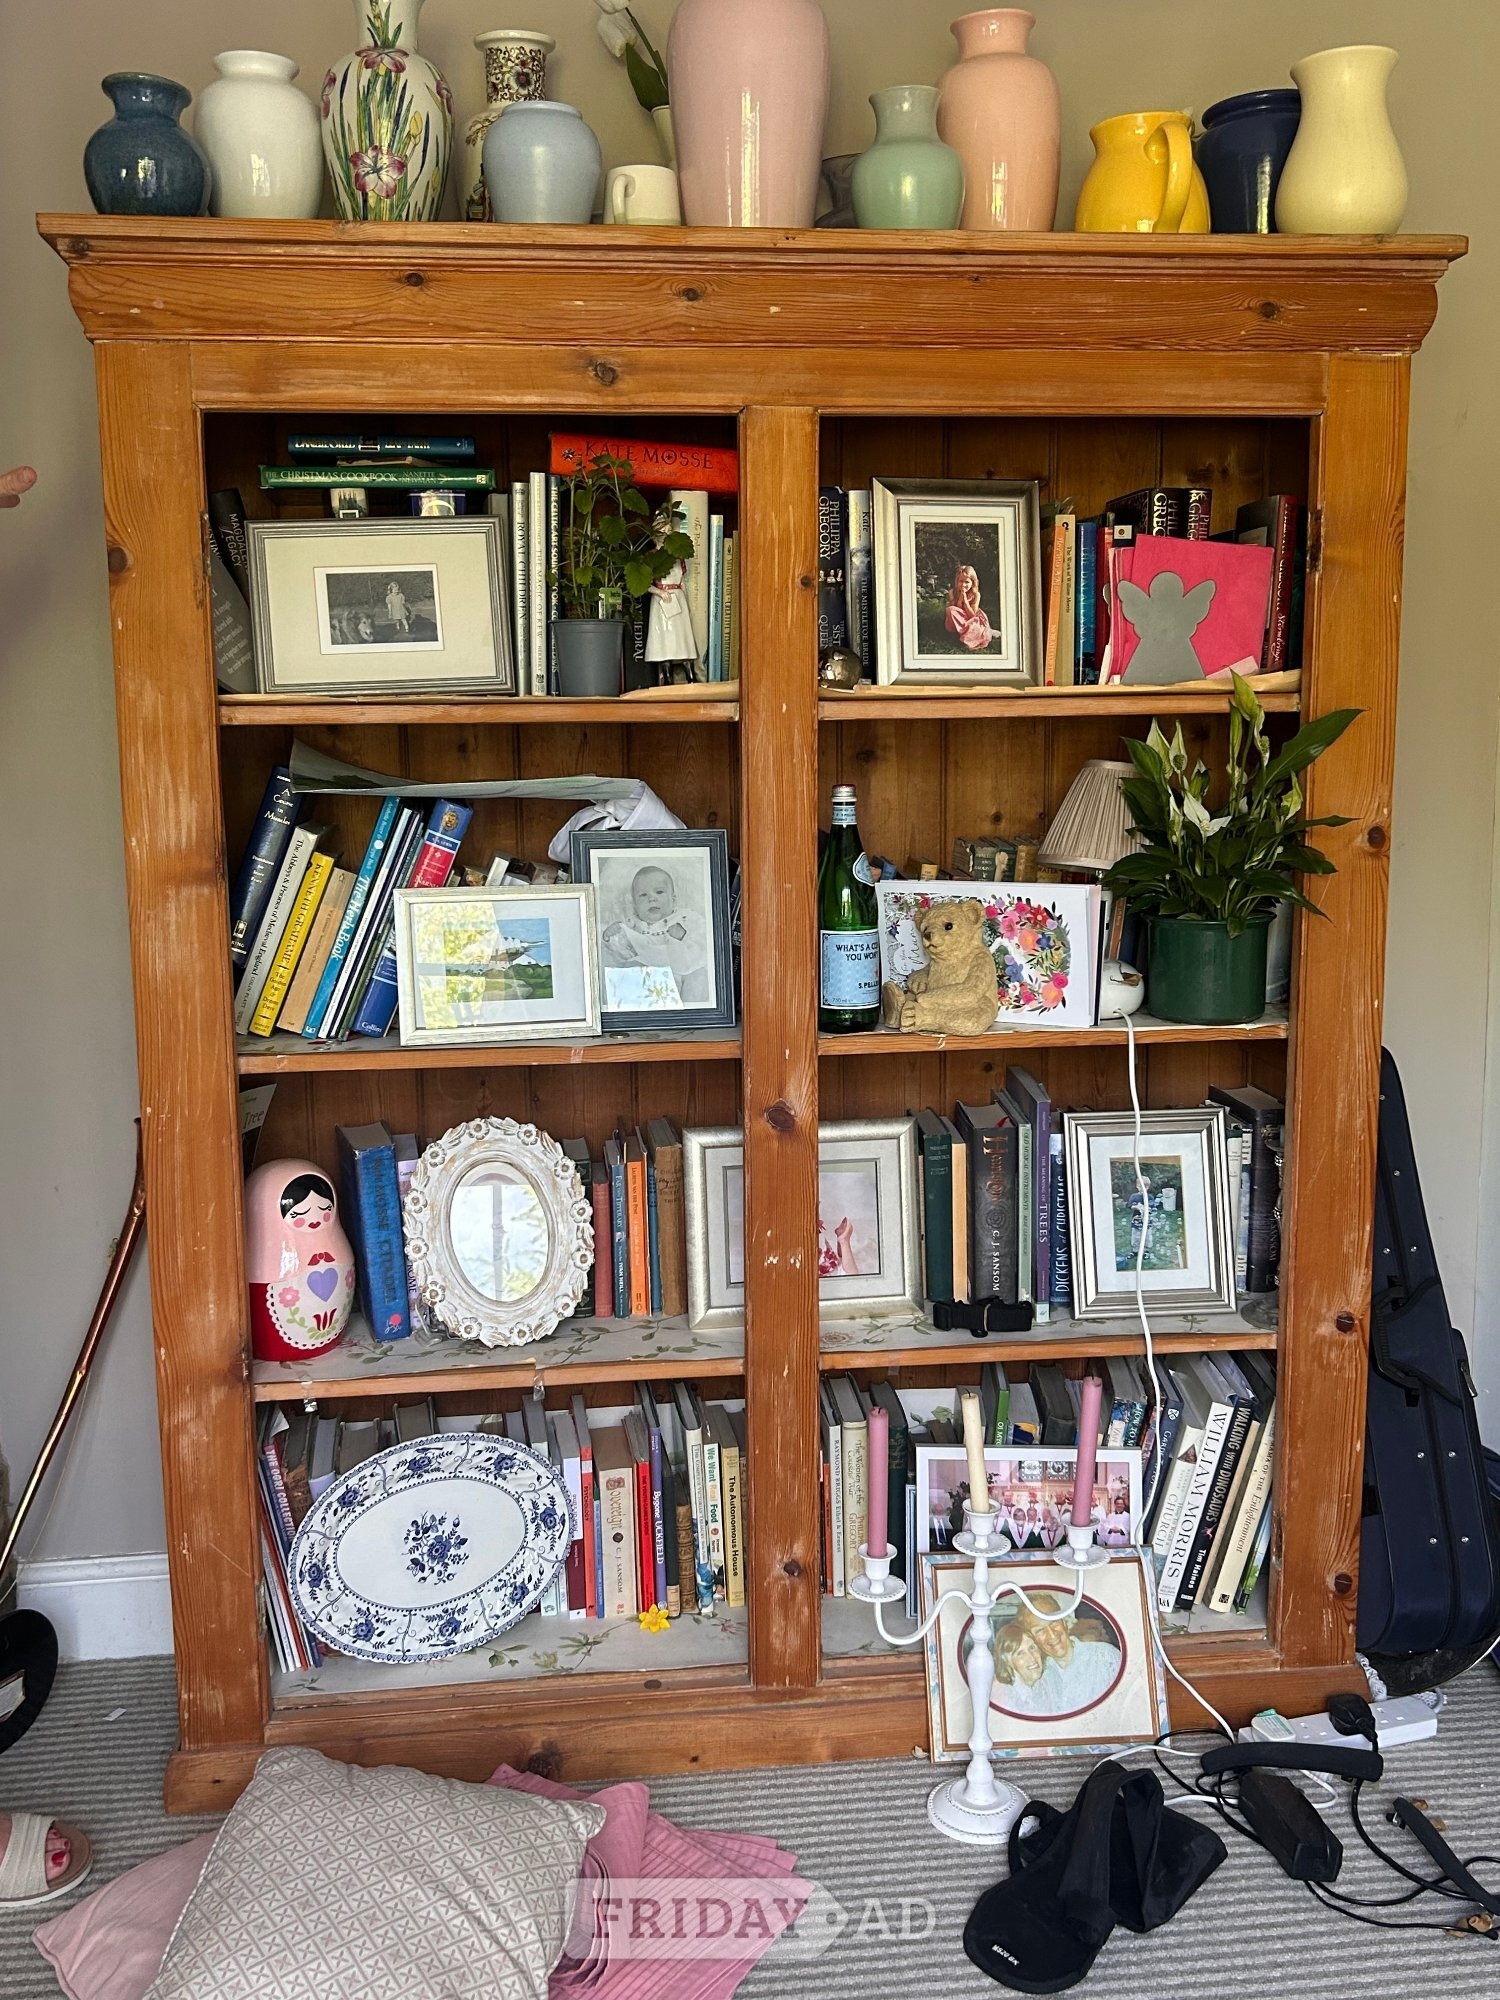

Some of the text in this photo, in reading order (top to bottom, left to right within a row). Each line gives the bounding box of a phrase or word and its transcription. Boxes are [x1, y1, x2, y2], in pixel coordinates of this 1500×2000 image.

[585, 440, 714, 469] KATE MOSSE
[281, 470, 337, 480] CHRISTMAS
[340, 471, 397, 482] COOKBOOK
[819, 496, 830, 560] GREGORY
[830, 501, 840, 555] PHILIPPA
[863, 512, 871, 533] Kate
[1168, 500, 1179, 536] PHIL
[517, 522, 527, 555] ROYAL
[517, 561, 527, 619] CHILDREN
[535, 571, 543, 601] MAGIC
[536, 604, 543, 615] OF
[832, 625, 841, 647] SIST
[281, 788, 290, 796] A
[255, 839, 304, 975] The Abbeys & Priories of Medieval England
[283, 863, 323, 964] KENNETH GRAHAME
[330, 875, 369, 962] The Herb Book
[835, 944, 864, 952] WHAT'S
[845, 953, 862, 961] YOU
[361, 1021, 382, 1033] Collins
[242, 1110, 265, 1131] Tree
[376, 1185, 389, 1231] MOSSE
[615, 1175, 624, 1228] FAR TIPPERARY
[991, 1230, 1000, 1240] C.
[1040, 1203, 1048, 1243] TREES
[379, 1240, 397, 1304] CITADEL
[992, 1251, 1000, 1291] SANSOM
[1055, 1247, 1070, 1292] DICKENS
[266, 1450, 278, 1467] THE
[854, 1440, 865, 1504] The Women of the
[1205, 1408, 1250, 1523] WALKING WITH DINOSAURS
[1258, 1467, 1267, 1477] OF
[707, 1448, 719, 1523] We Want Real Food
[1168, 1413, 1227, 1577] WILLIAM MORRIS
[652, 1491, 664, 1564] Bygone UCKFIELD
[729, 1494, 738, 1549] Autonomous
[848, 1513, 857, 1549] GREGORY
[857, 1516, 865, 1545] PHILIPP
[1155, 1494, 1178, 1548] CHURCH
[616, 1563, 624, 1593] SANSOM
[731, 1550, 739, 1577] House
[1188, 1549, 1206, 1588] Tim Haines
